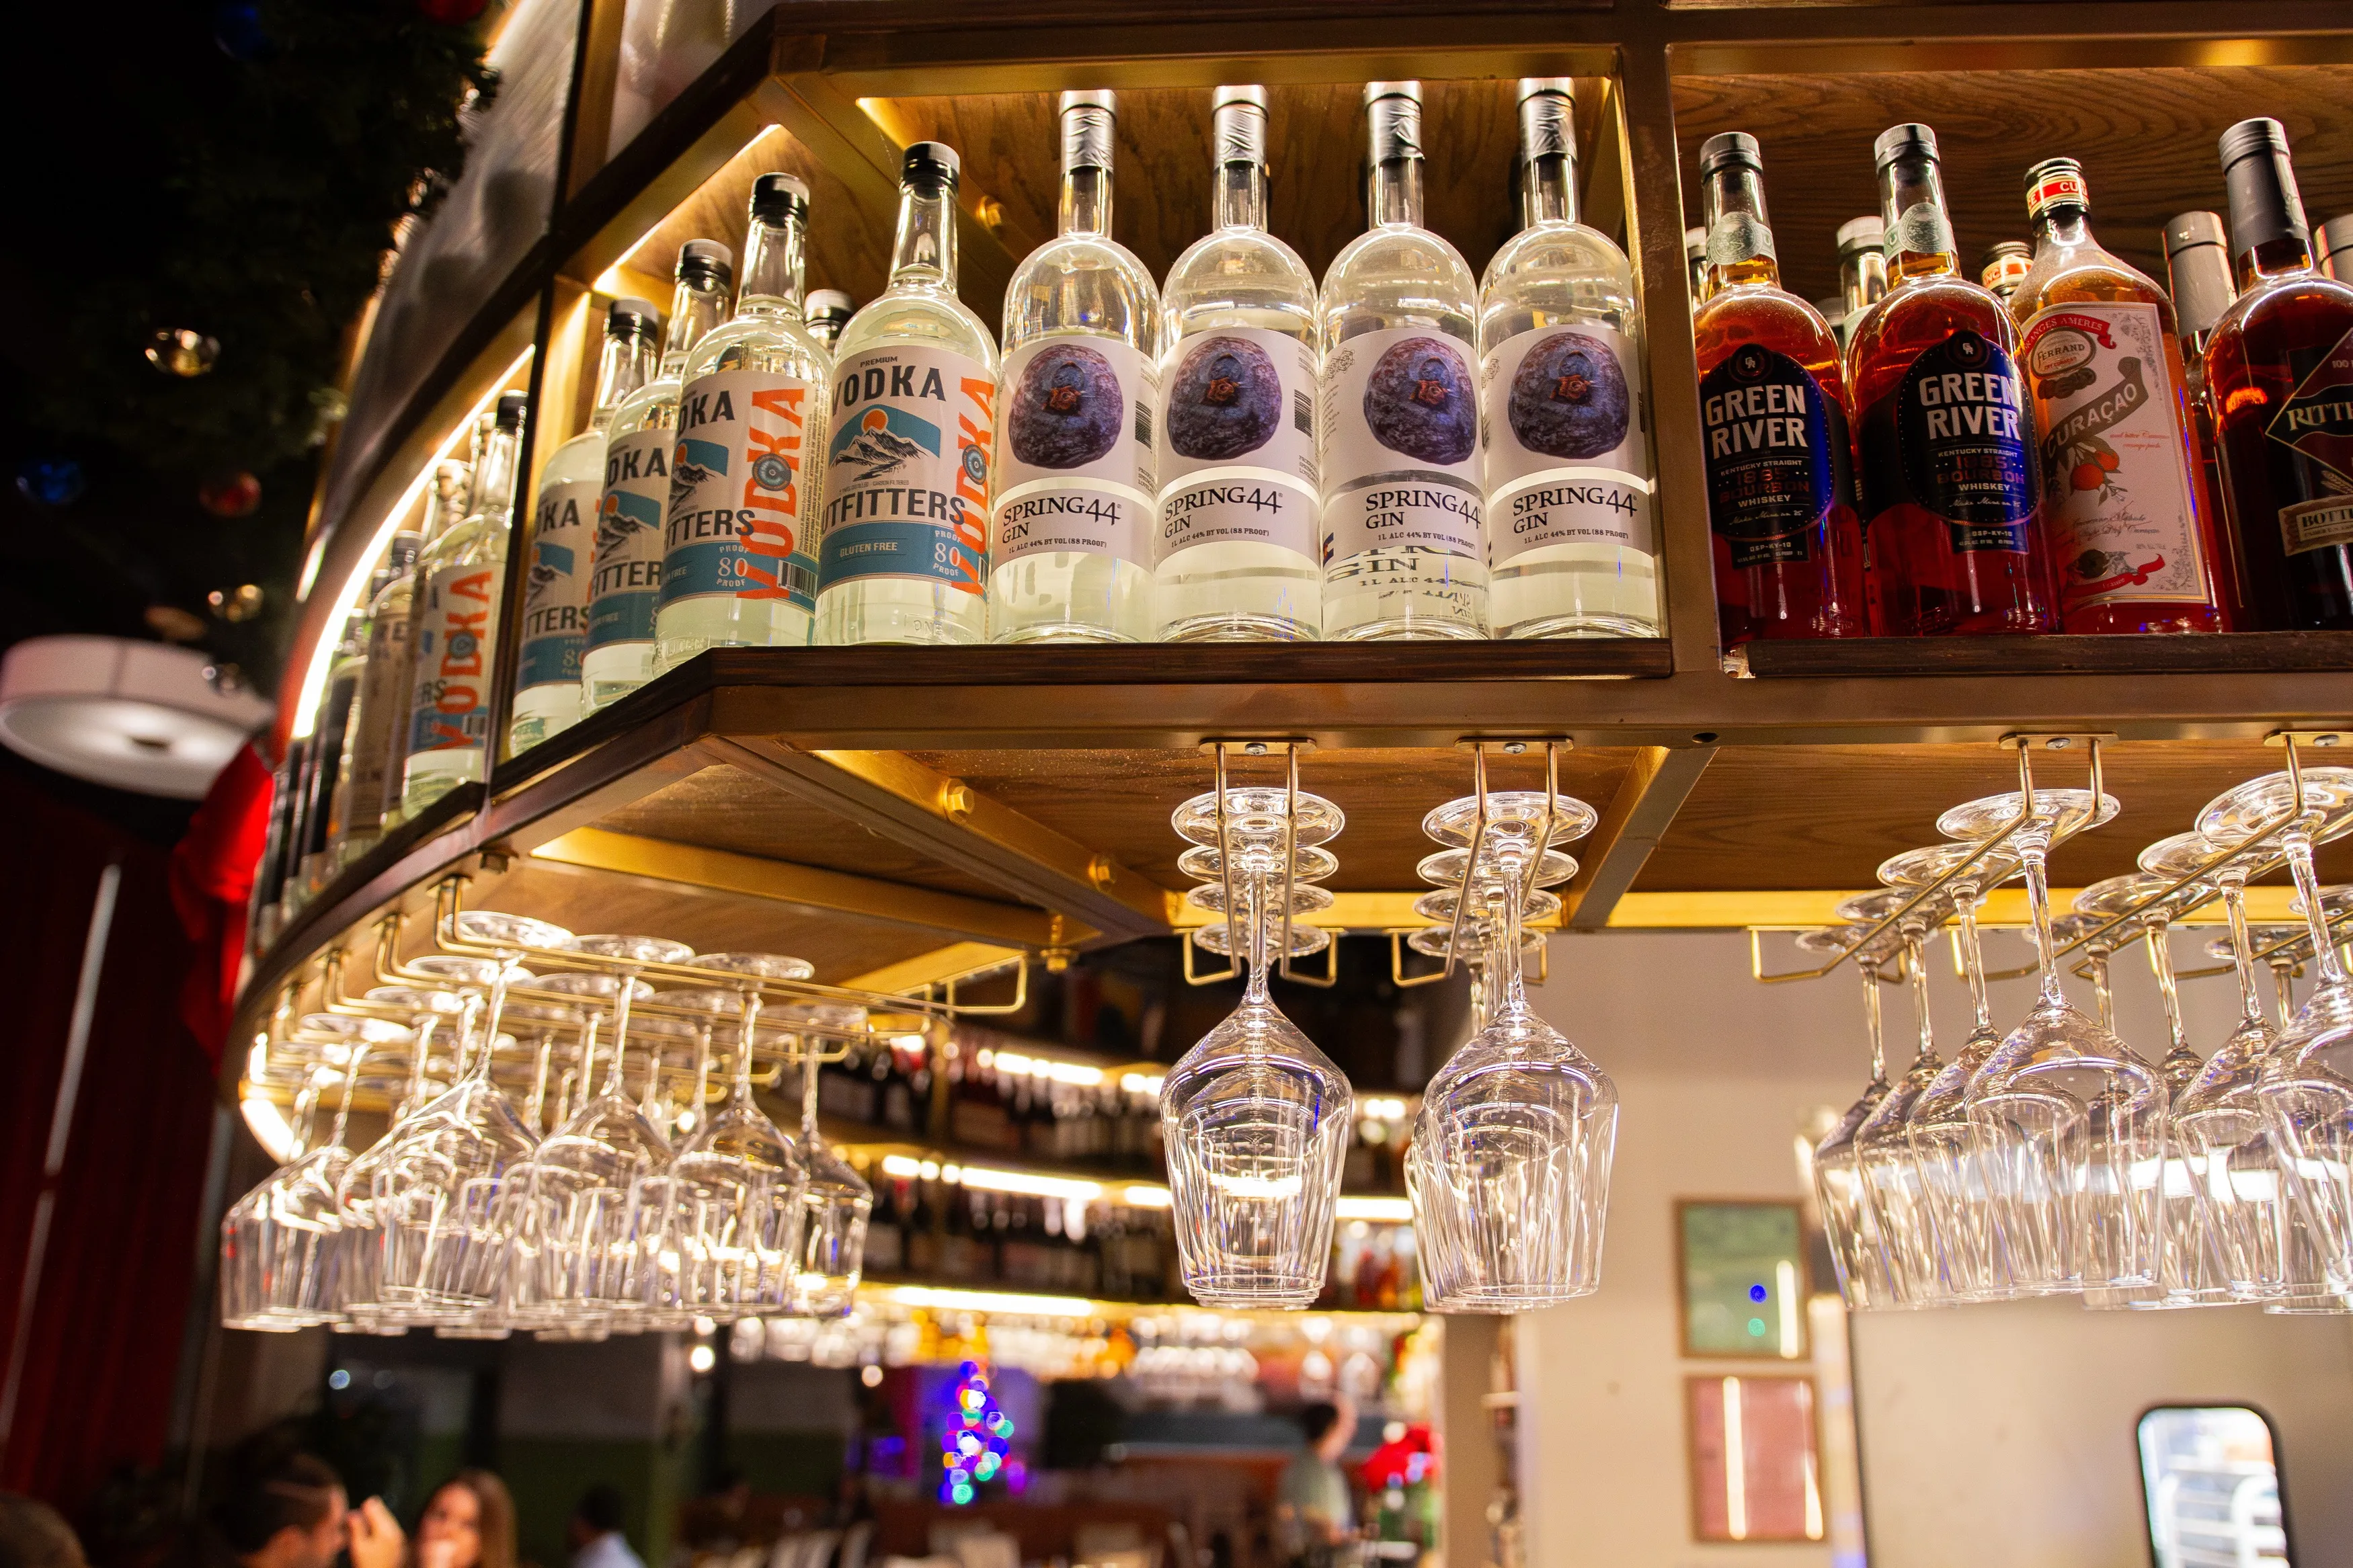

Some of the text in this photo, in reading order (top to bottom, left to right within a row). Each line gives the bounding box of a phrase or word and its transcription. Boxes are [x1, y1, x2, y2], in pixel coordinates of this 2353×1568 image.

[860, 356, 898, 368] PREMIUM
[2037, 343, 2085, 368] FERRAND
[1919, 372, 2019, 408] GREEN
[1706, 384, 1806, 426] GREEN
[1926, 406, 2023, 441] RIVER
[2048, 383, 2137, 458] CURAÇAO
[1711, 417, 1808, 460] RIVER
[1938, 448, 2018, 458] KENTUCKY STRAIGHT
[1720, 460, 1802, 477] KENTUCKY STRAIGHT
[1937, 469, 2025, 484] BOURBON
[736, 388, 805, 600] VODKA
[951, 376, 994, 595] VODKA
[1719, 481, 1810, 503] BOURBON
[1958, 483, 2010, 491] WHISKEY
[1738, 495, 1791, 508] WHISKEY
[1165, 515, 1191, 538] GIN
[1366, 511, 1404, 529] GIN
[1514, 512, 1548, 534] GIN
[934, 530, 962, 542] PROOF
[1002, 522, 1030, 544] GIN
[1179, 535, 1191, 544] ALC
[1192, 530, 1205, 539] 44%
[1244, 528, 1269, 536] PROOF)
[1535, 533, 1548, 541] ALC
[1605, 530, 1628, 540] PROOF)
[719, 544, 749, 554] PROOF
[840, 542, 898, 558] GLUTEN FREE
[1016, 542, 1029, 551] ALC
[1030, 538, 1043, 547] 44%
[1082, 538, 1107, 548] PROOF)
[934, 542, 961, 567] 80
[717, 557, 749, 577] 80
[933, 563, 959, 577] PROOF
[717, 578, 746, 587] PROOF
[429, 571, 493, 751] VODKA
